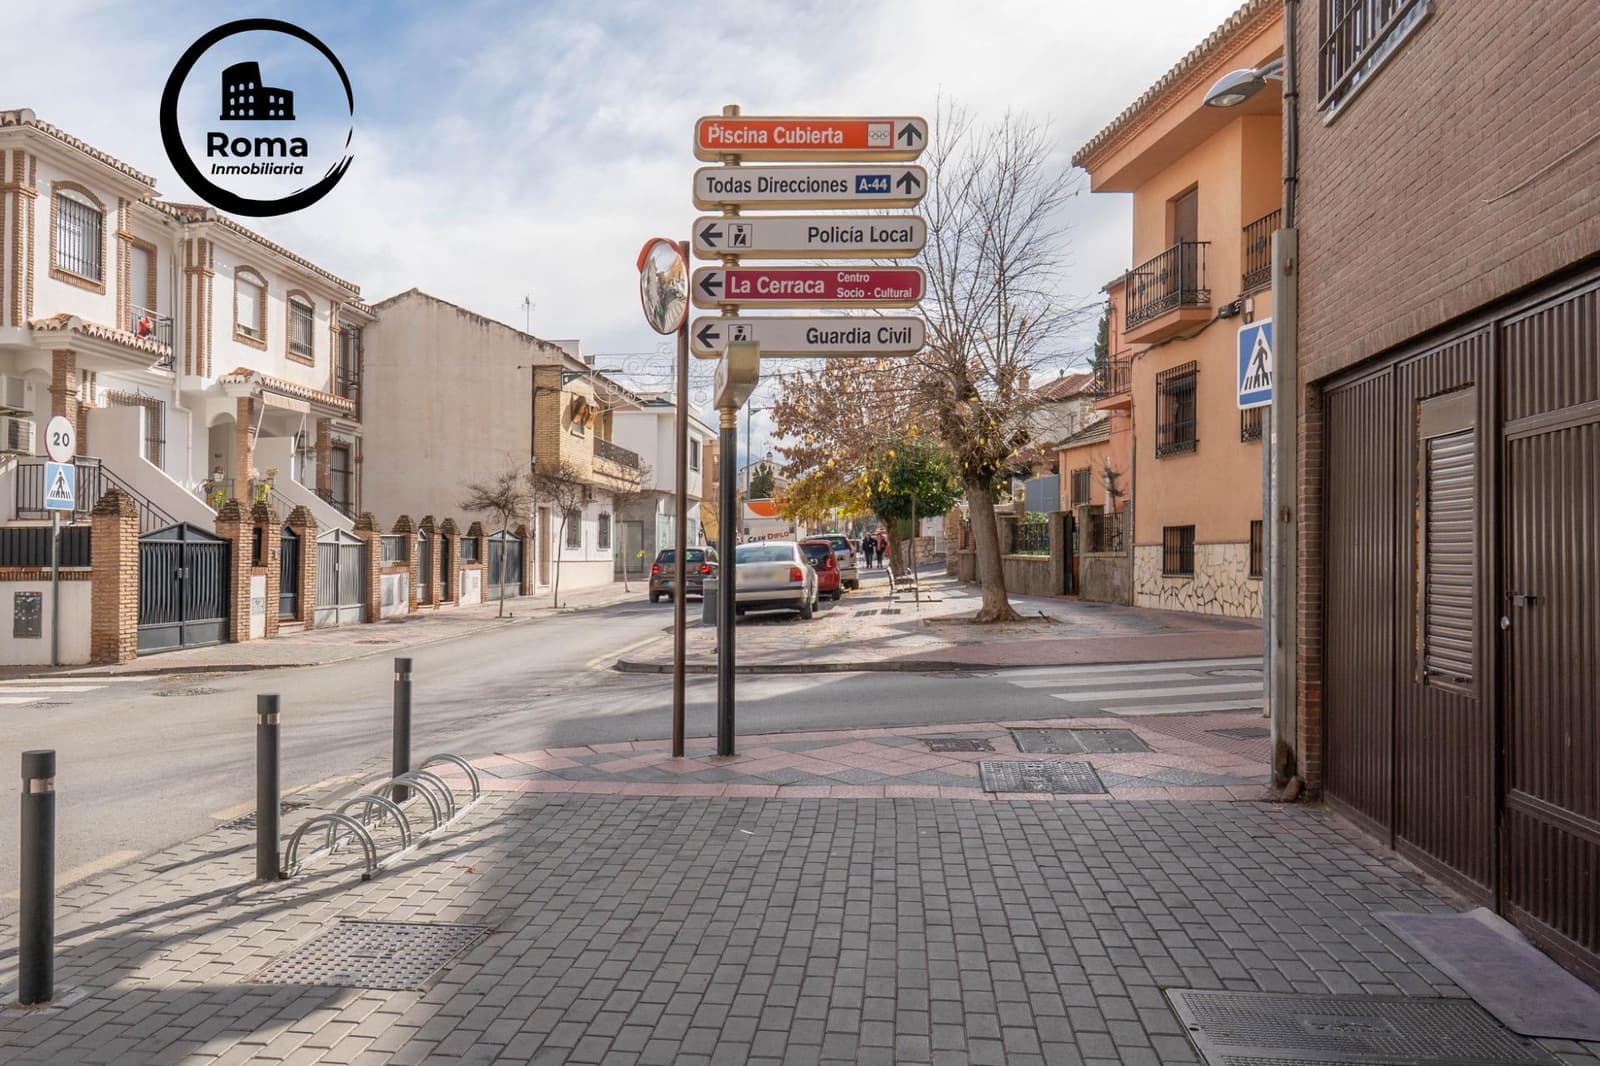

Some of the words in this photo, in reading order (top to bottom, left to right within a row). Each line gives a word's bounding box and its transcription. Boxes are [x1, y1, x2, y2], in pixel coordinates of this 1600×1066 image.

[708, 126, 768, 144] Piscina
[773, 126, 843, 144] Cubierta
[706, 176, 752, 193] Todas
[757, 176, 848, 193] Direcciones
[858, 178, 888, 191] A-44
[808, 226, 863, 243] Policía
[870, 226, 913, 243] Local
[731, 276, 750, 294] La
[757, 276, 825, 294] Cerraca
[837, 272, 870, 283] Centro
[836, 287, 865, 298] Socio
[874, 287, 912, 298] Cultural
[806, 327, 871, 345] Guardia
[877, 327, 912, 344] Civil
[53, 432, 70, 447] 20
